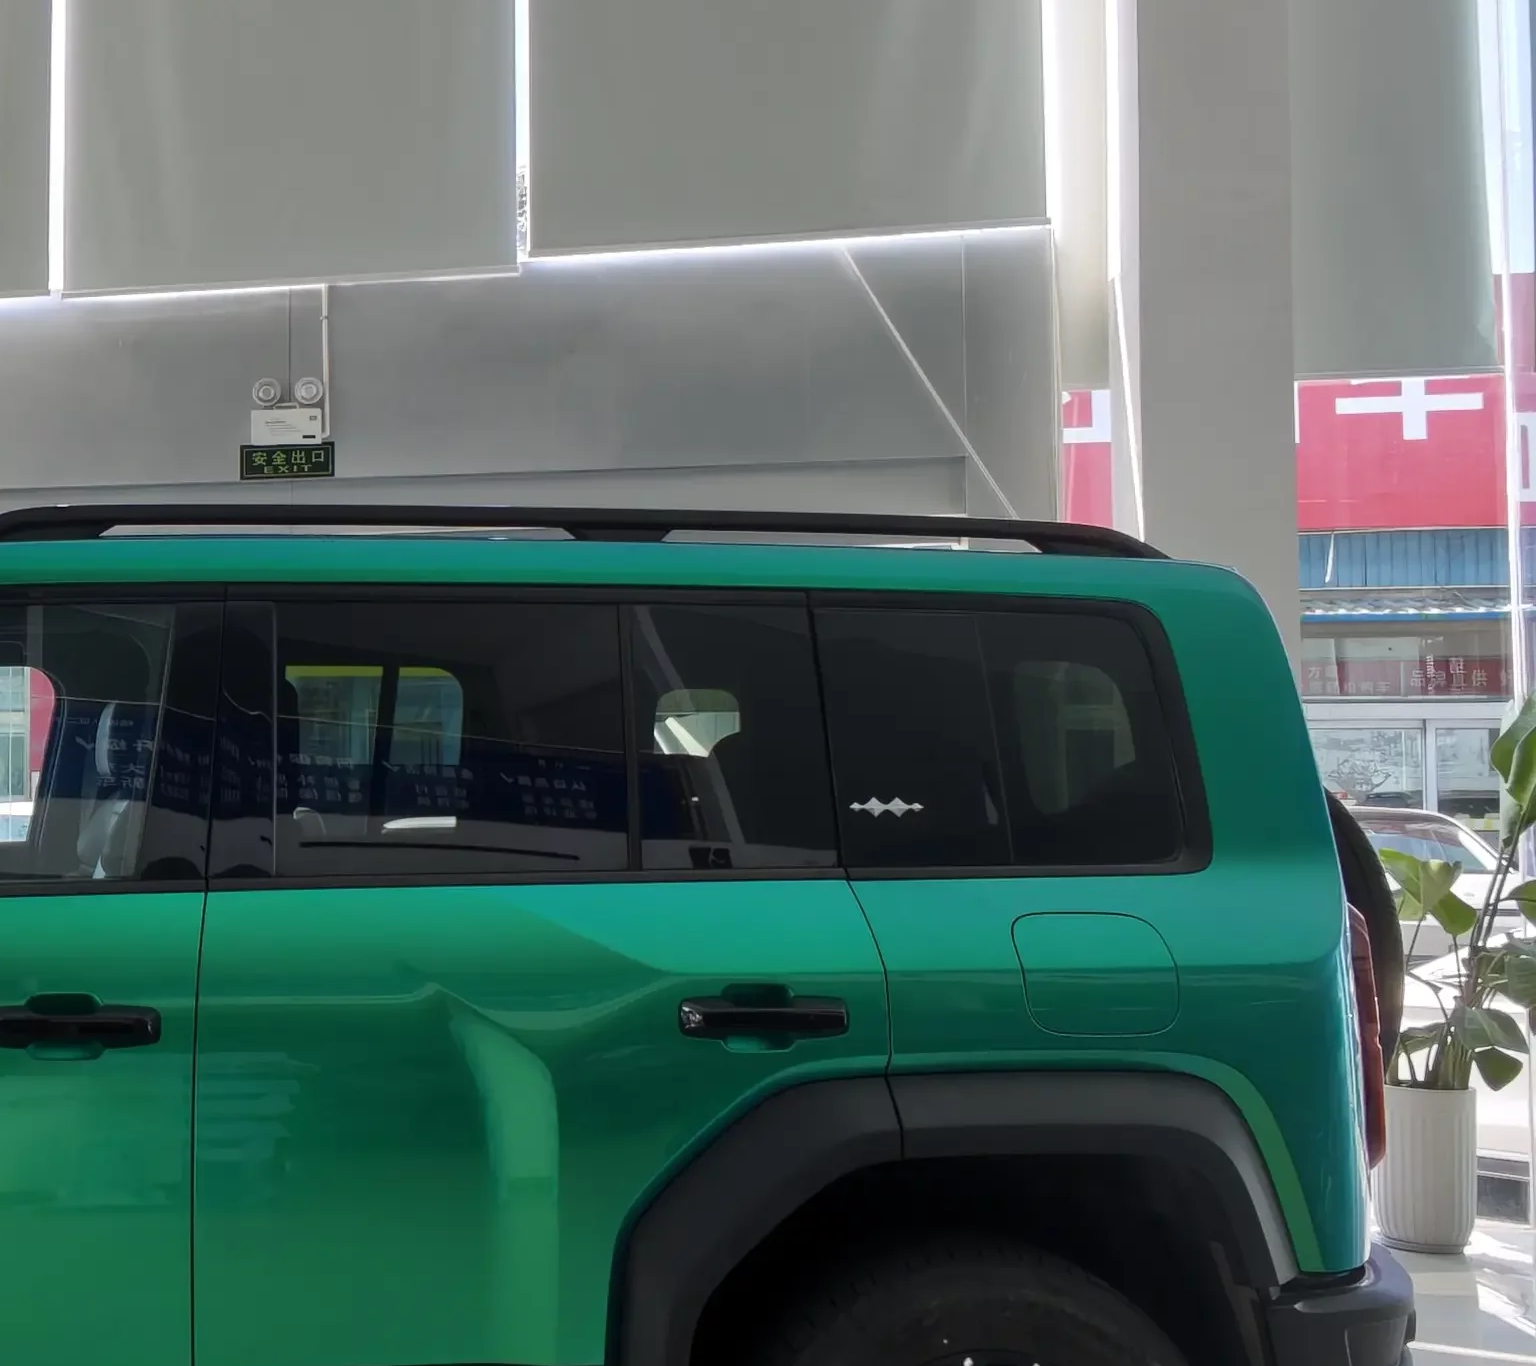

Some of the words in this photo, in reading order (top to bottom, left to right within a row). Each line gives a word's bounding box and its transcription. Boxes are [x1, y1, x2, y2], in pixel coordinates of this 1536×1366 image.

[252, 450, 325, 466] 安全出口
[263, 465, 312, 474] EXIT
